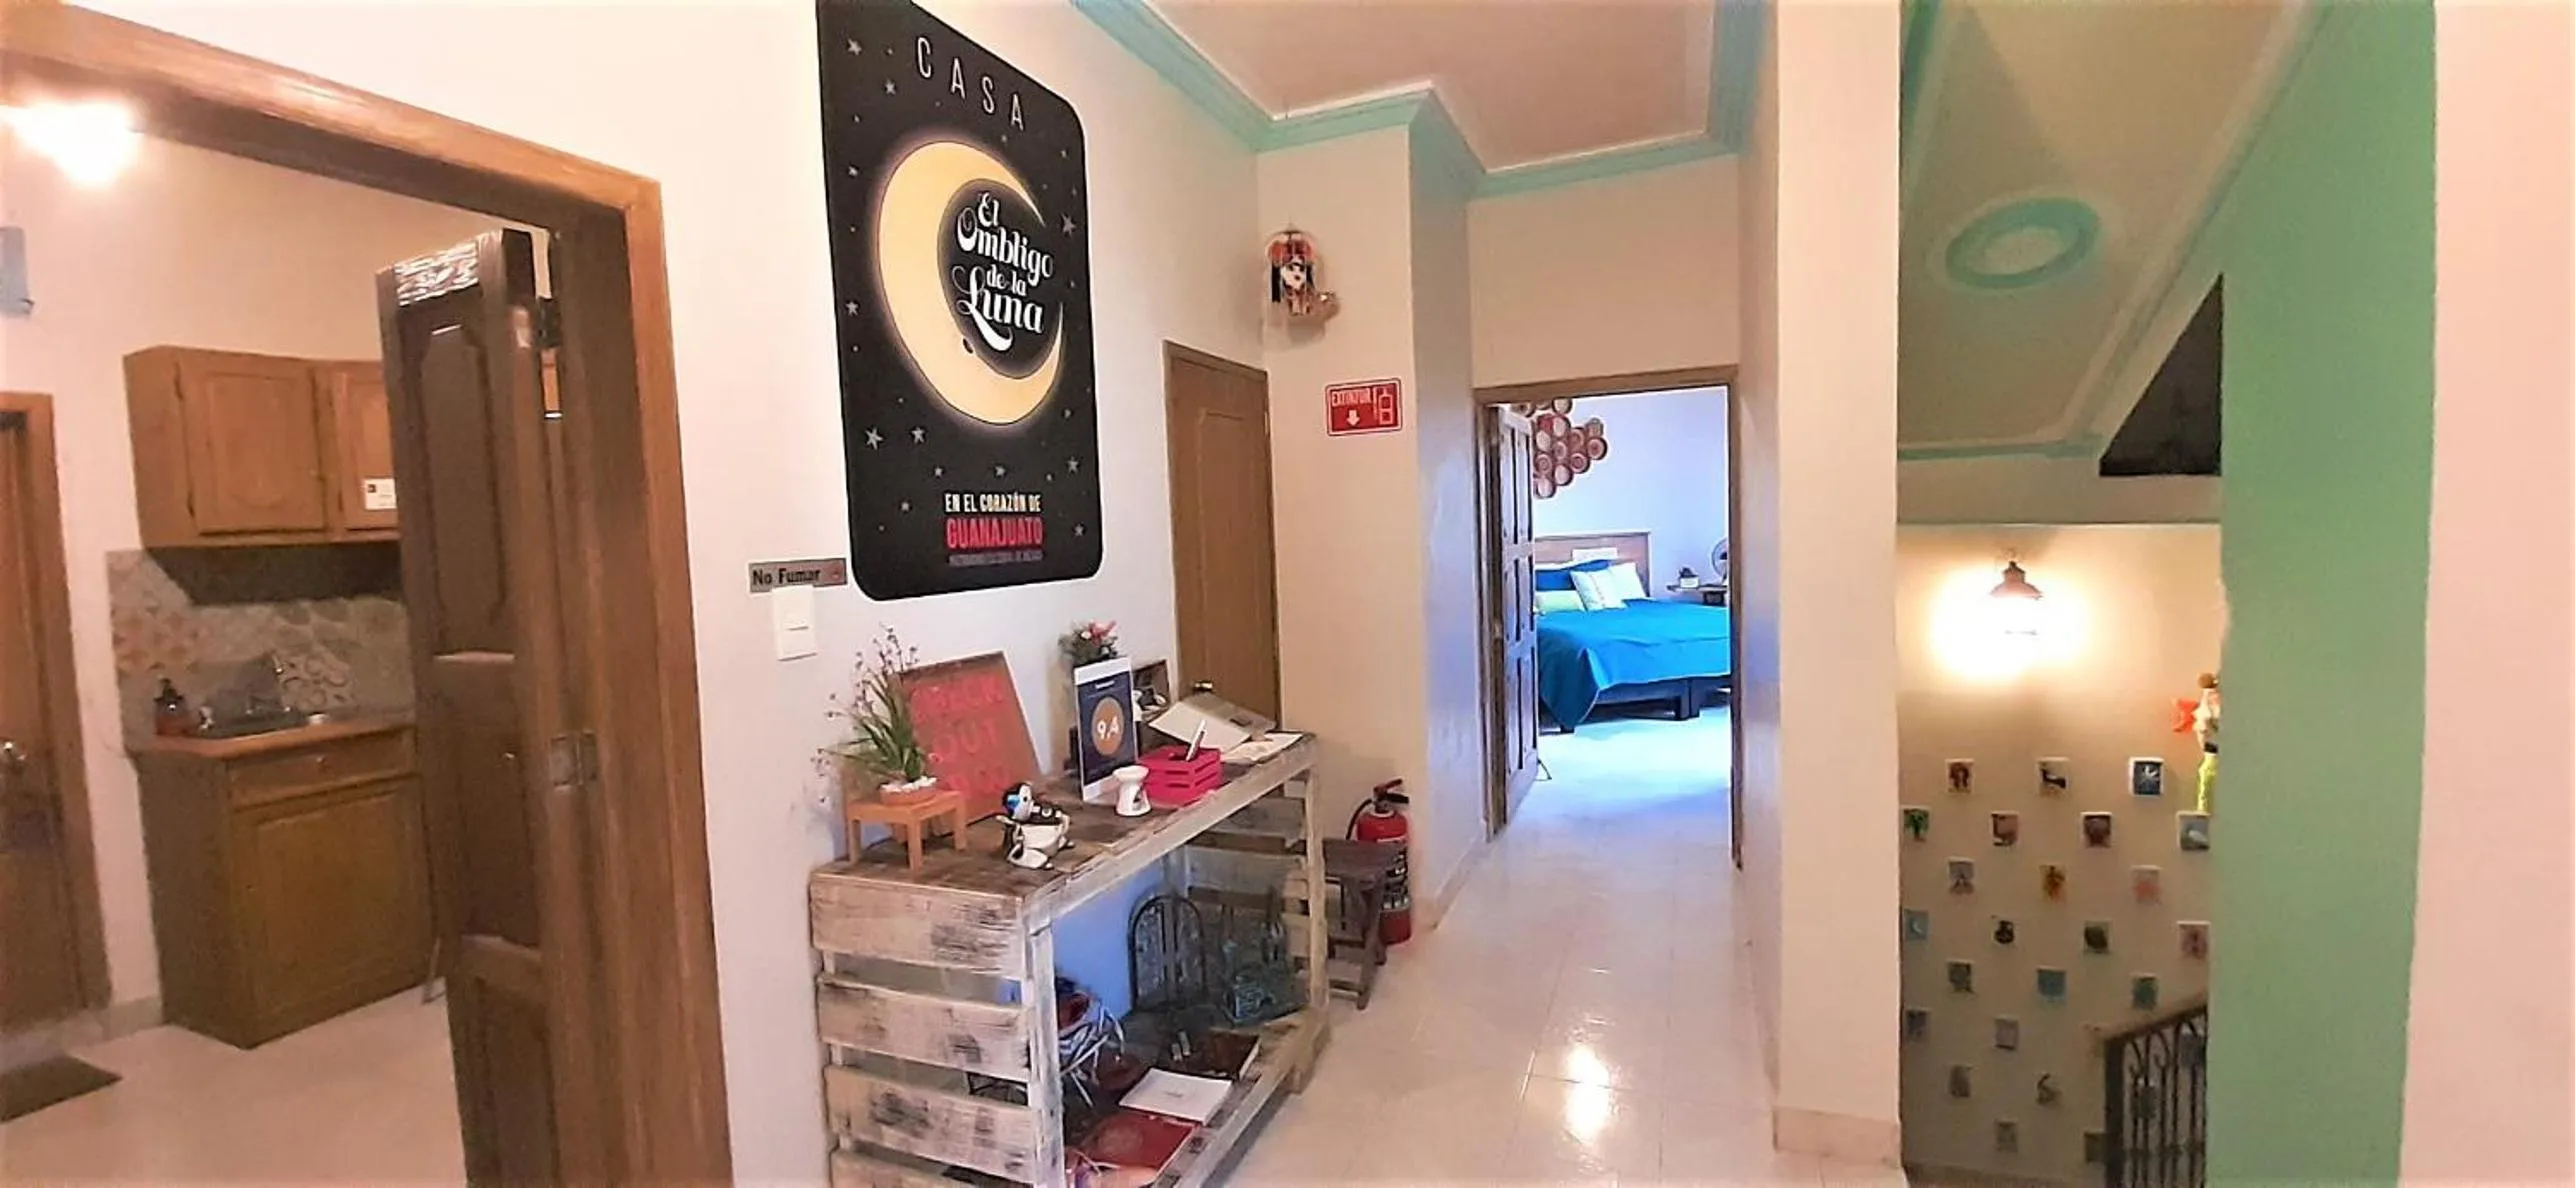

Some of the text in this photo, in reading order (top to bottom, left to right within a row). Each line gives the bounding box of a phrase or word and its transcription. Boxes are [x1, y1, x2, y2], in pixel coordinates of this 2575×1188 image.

[917, 36, 1024, 131] CASA
[978, 191, 999, 227] El
[957, 207, 1053, 286] Ombligo
[986, 264, 1027, 296] de la
[952, 266, 1043, 351] Luna
[945, 490, 1041, 512] EN EL CORAZÓN DE
[946, 517, 1043, 549] GUANAJUATO
[753, 567, 820, 585] No Fumar
[932, 717, 998, 759] OUT
